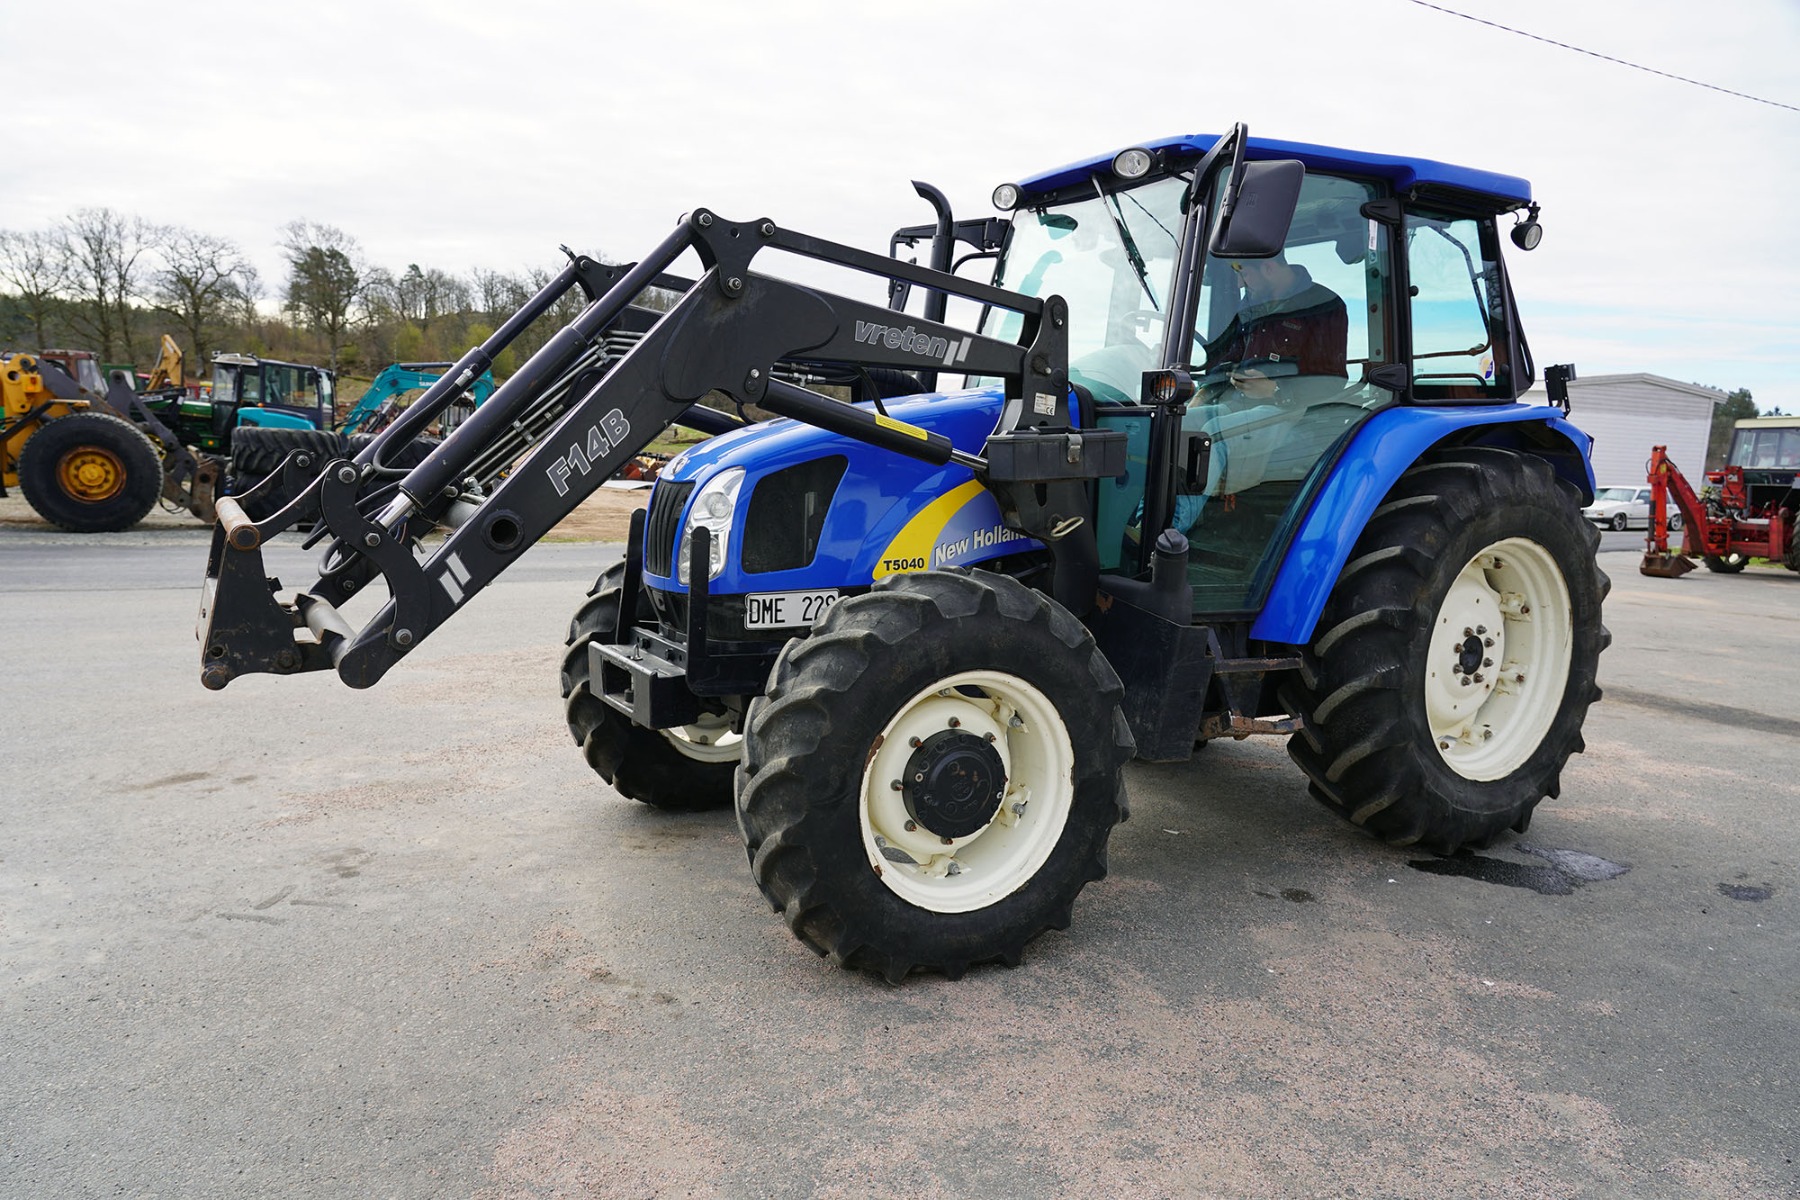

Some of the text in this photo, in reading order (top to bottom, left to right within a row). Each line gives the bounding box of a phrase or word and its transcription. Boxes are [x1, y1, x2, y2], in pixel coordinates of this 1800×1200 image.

[855, 320, 948, 358] vreten
[546, 408, 630, 497] F14B
[883, 558, 925, 571] T5040
[934, 537, 969, 567] New
[749, 598, 786, 624] DME
